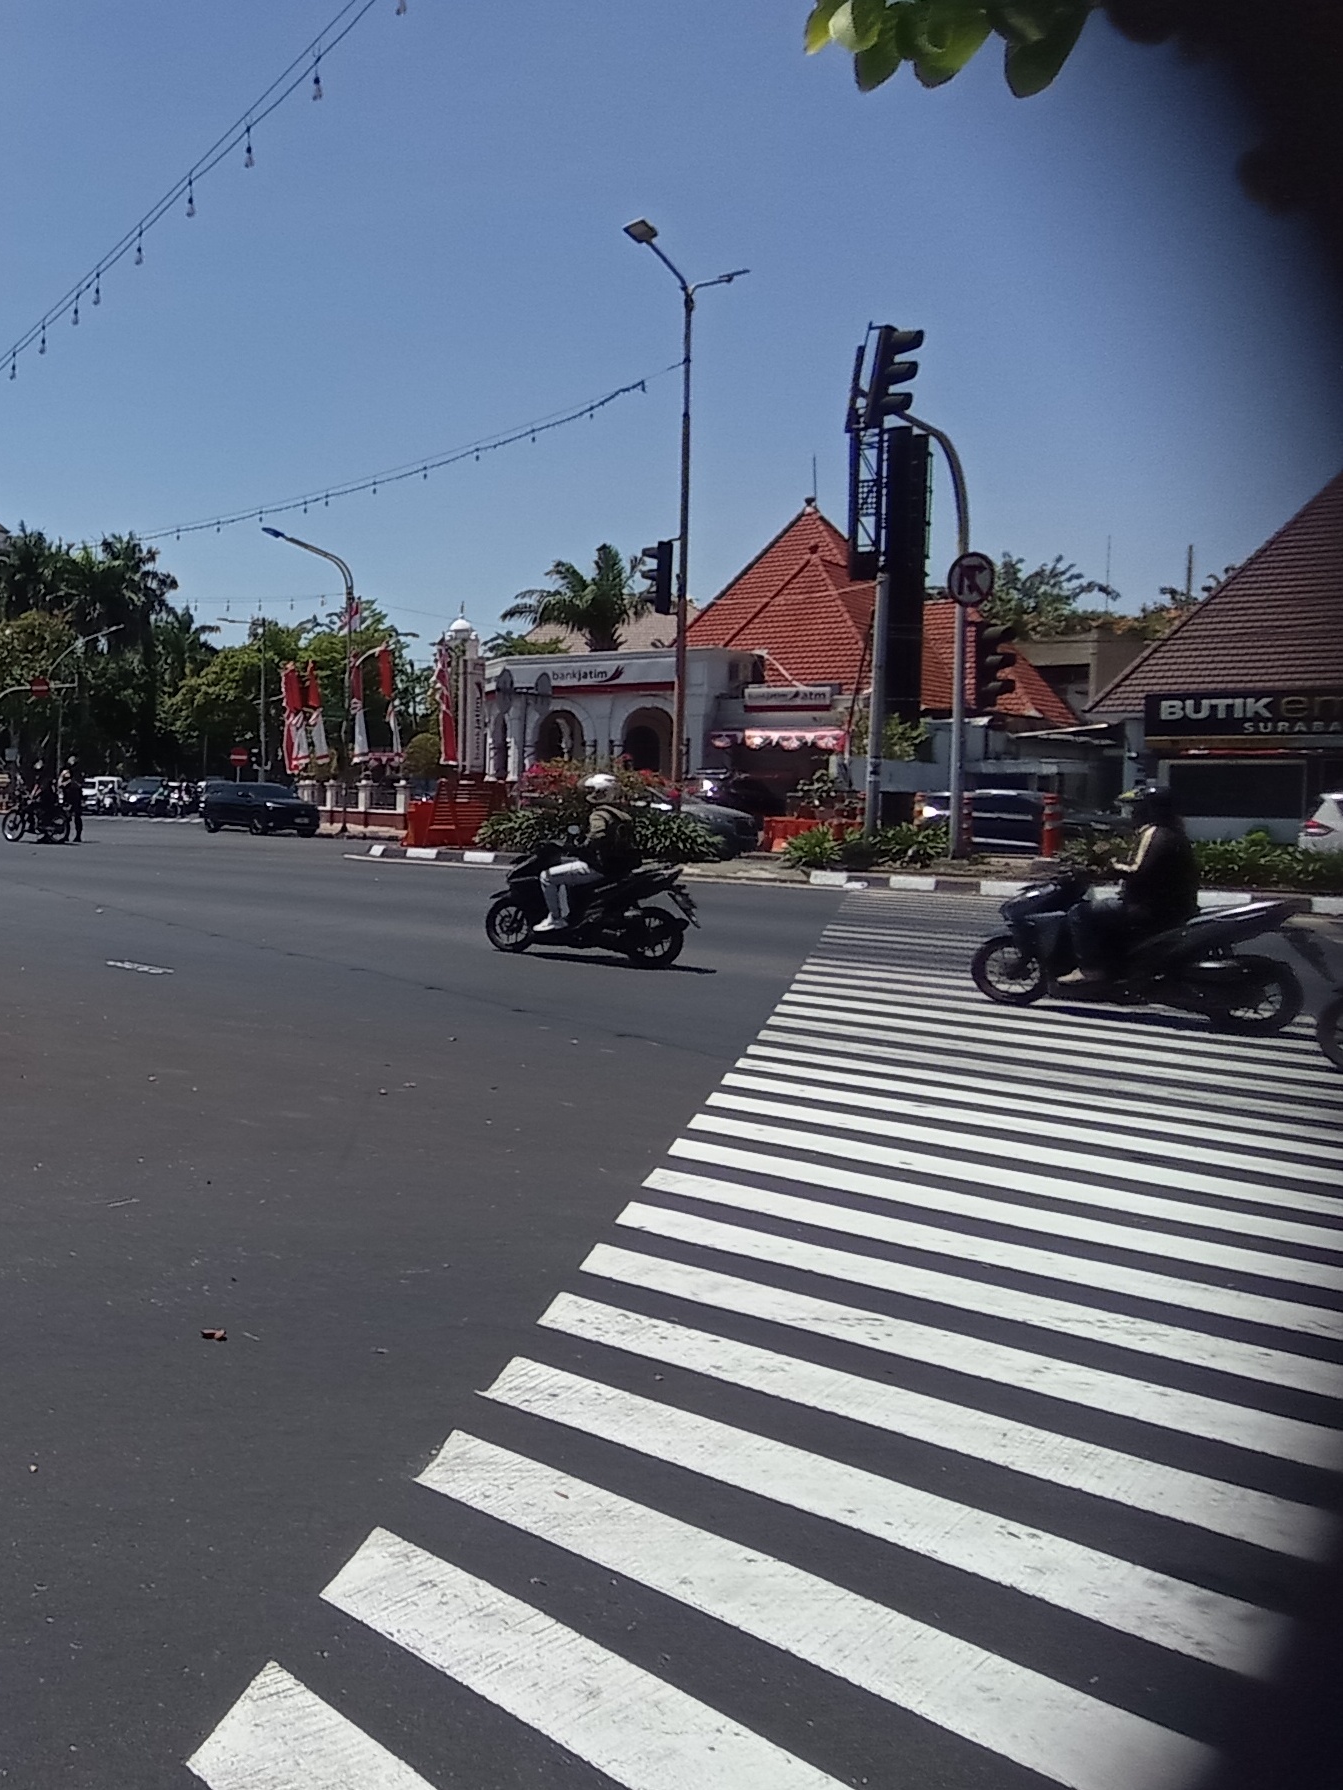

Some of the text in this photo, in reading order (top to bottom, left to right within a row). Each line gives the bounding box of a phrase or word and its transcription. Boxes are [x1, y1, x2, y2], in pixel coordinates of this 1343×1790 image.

[552, 669, 608, 682] bankjatim
[800, 691, 827, 700] atm
[1160, 697, 1274, 721] BUTIK
